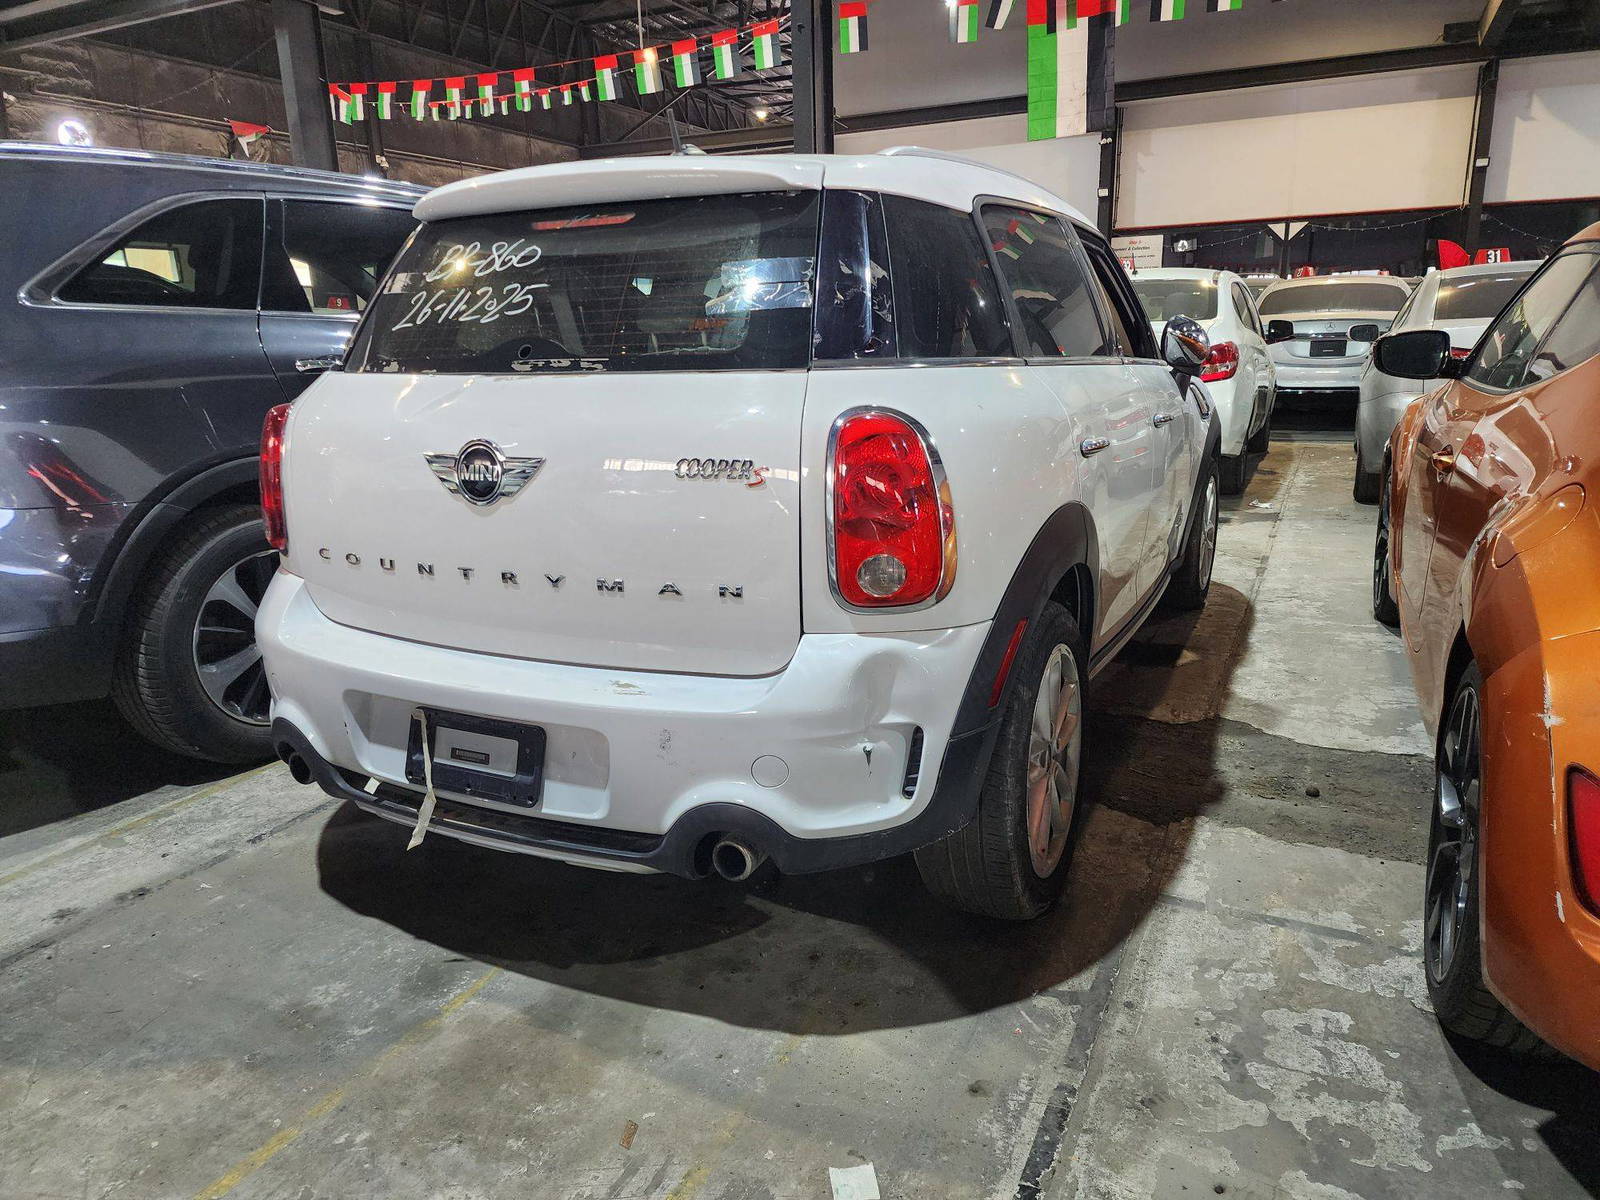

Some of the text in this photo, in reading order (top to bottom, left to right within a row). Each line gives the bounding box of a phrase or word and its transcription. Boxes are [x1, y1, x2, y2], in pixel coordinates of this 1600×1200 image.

[1487, 249, 1500, 264] 31
[460, 462, 498, 482] MINI
[675, 458, 770, 488] COOPER S
[318, 546, 745, 600] COUNTRYMAN
